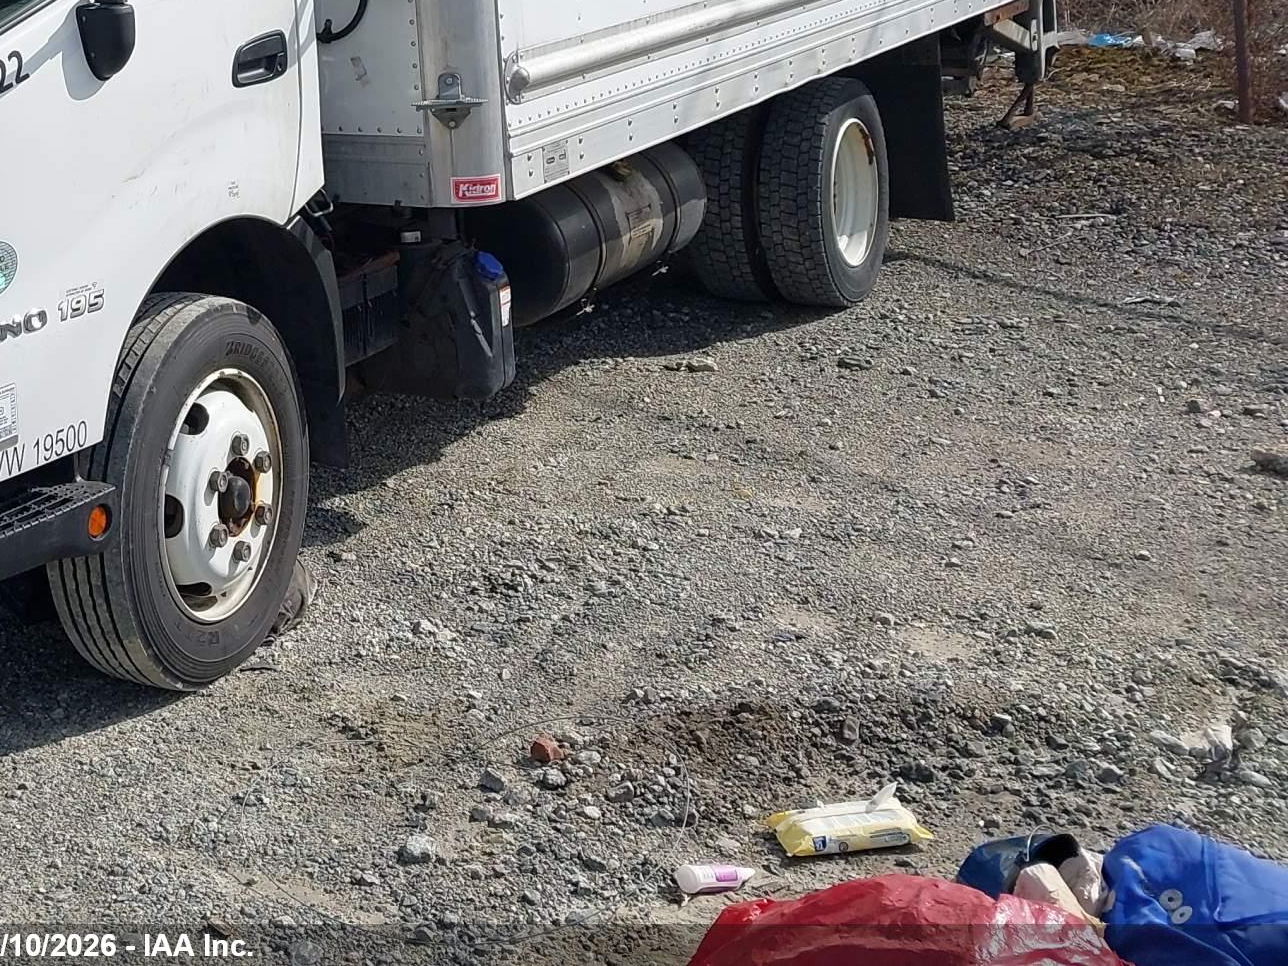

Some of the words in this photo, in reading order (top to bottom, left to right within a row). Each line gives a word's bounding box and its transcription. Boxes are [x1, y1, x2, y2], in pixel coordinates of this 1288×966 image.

[458, 183, 497, 198] Kidron
[57, 288, 105, 323] 195
[33, 420, 88, 466] 19500
